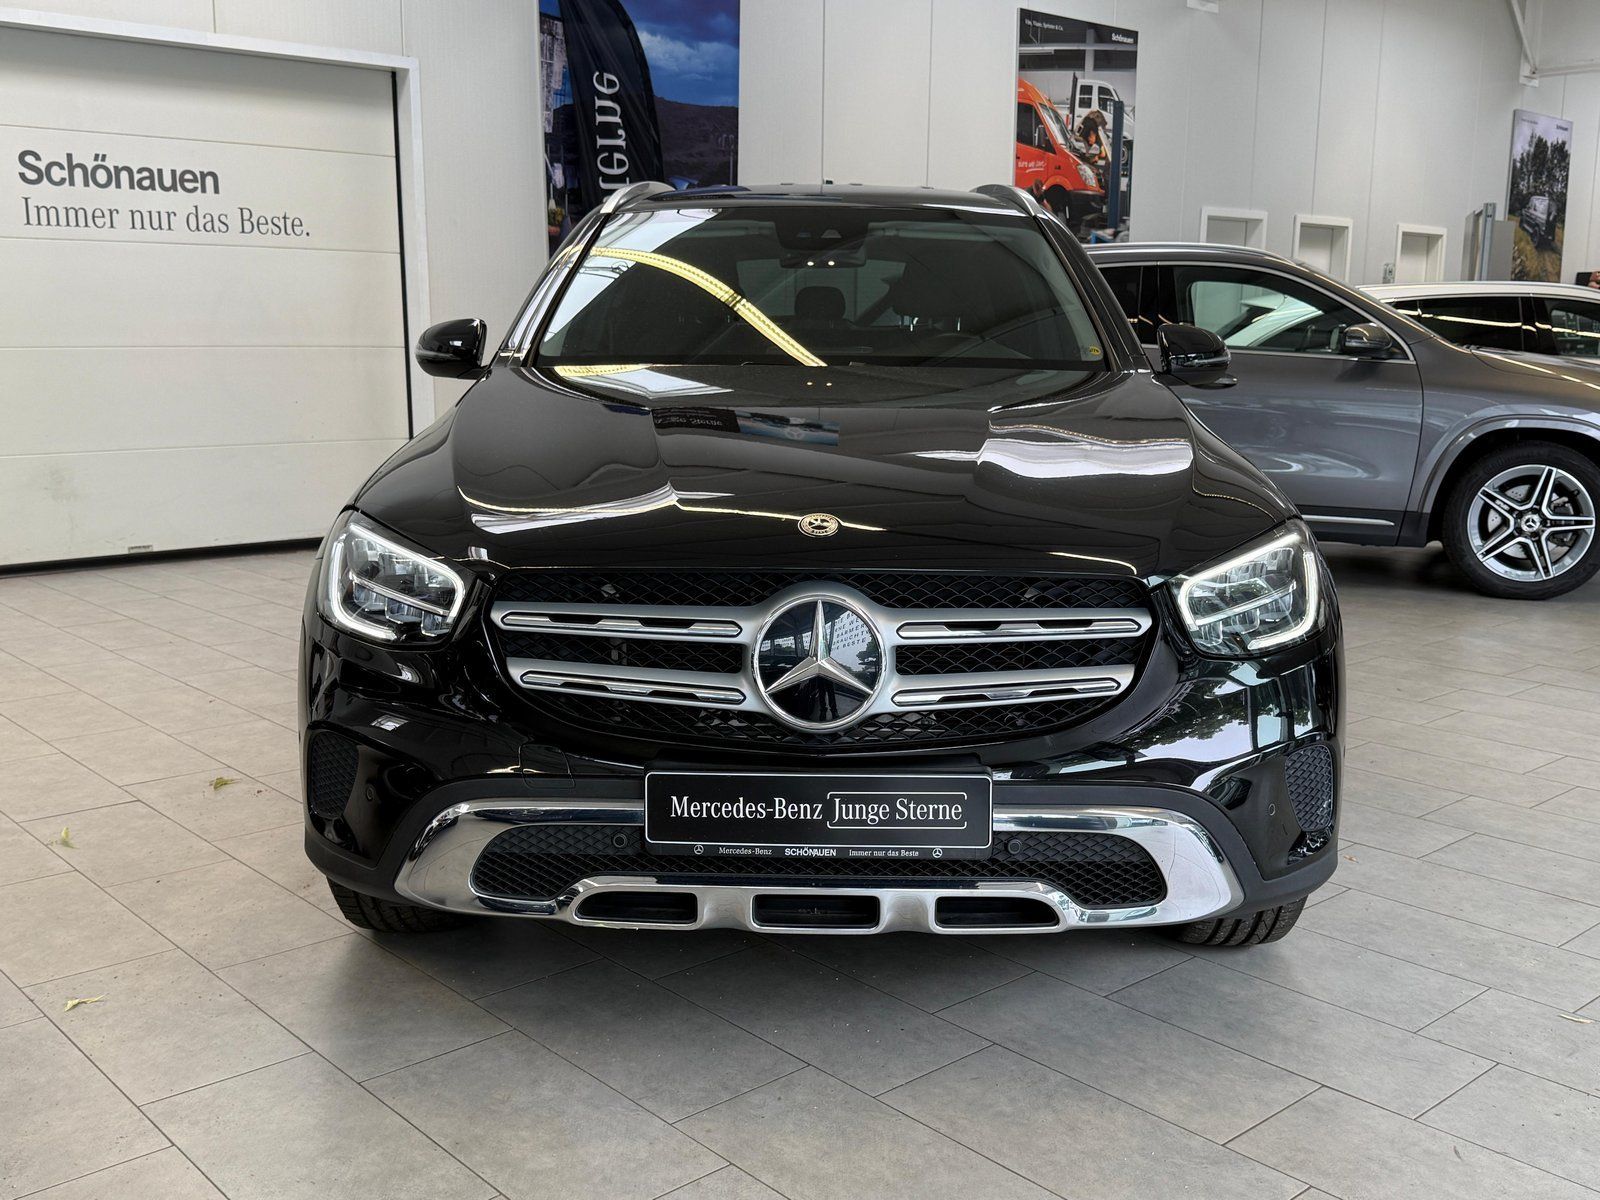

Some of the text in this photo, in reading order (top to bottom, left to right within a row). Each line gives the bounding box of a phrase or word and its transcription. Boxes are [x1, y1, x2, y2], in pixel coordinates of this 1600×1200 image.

[17, 149, 220, 195] Schönauen
[21, 196, 310, 237] Immer nur das Beste.
[670, 795, 963, 825] Mercedes-Benz Junge Sterne
[718, 846, 773, 856] Mercedes-Benz
[784, 846, 837, 858] SCHÖNAUEN
[848, 849, 872, 857] Immer
[887, 849, 899, 857] das
[900, 849, 919, 857] Beste
